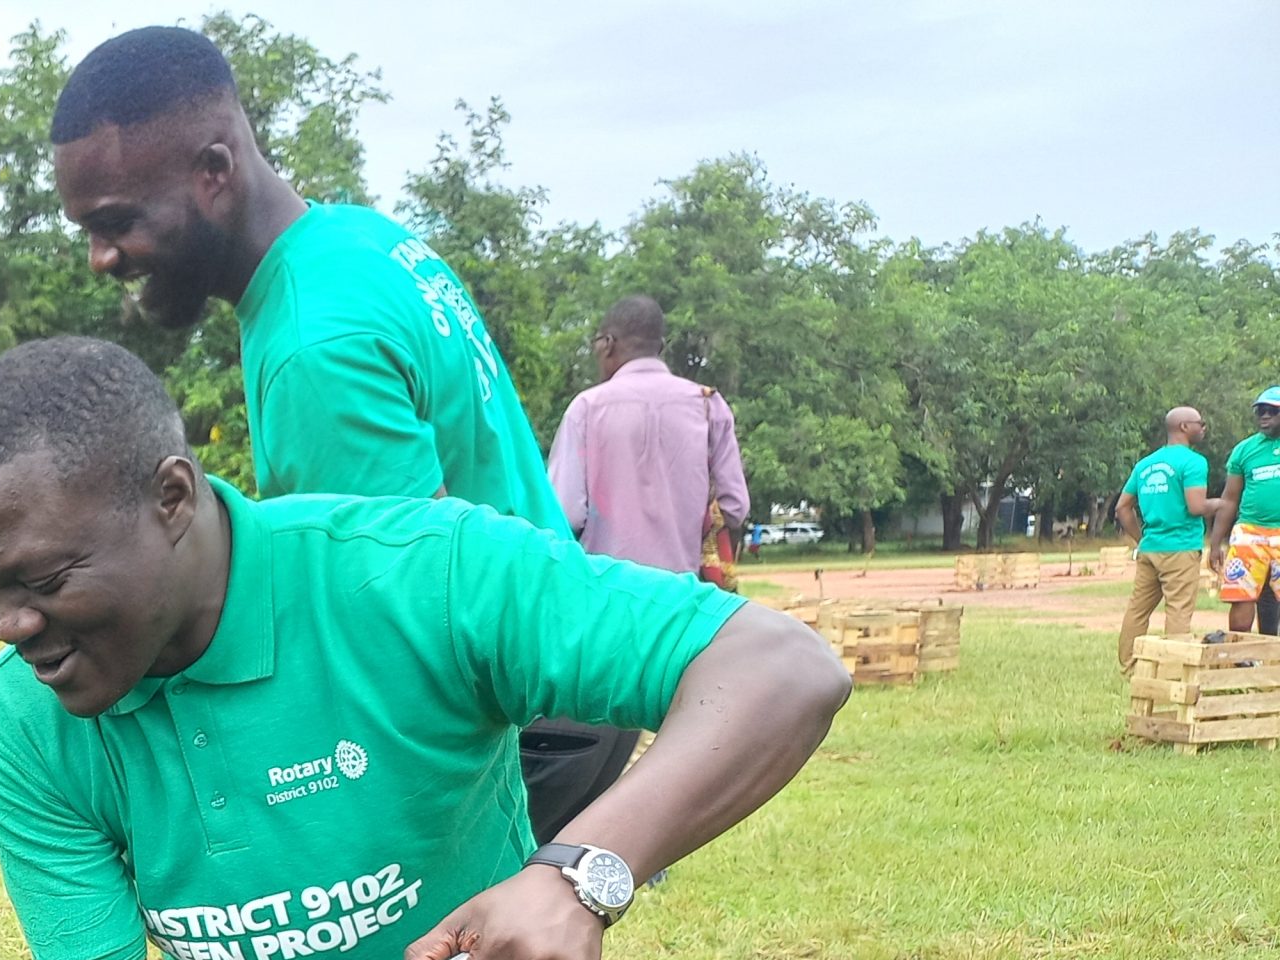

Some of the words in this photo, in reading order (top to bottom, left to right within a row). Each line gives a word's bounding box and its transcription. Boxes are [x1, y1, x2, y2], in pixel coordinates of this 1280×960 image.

[268, 754, 333, 787] Rotary
[266, 785, 308, 806] District
[307, 775, 340, 794] 9102
[300, 863, 405, 920] 9102
